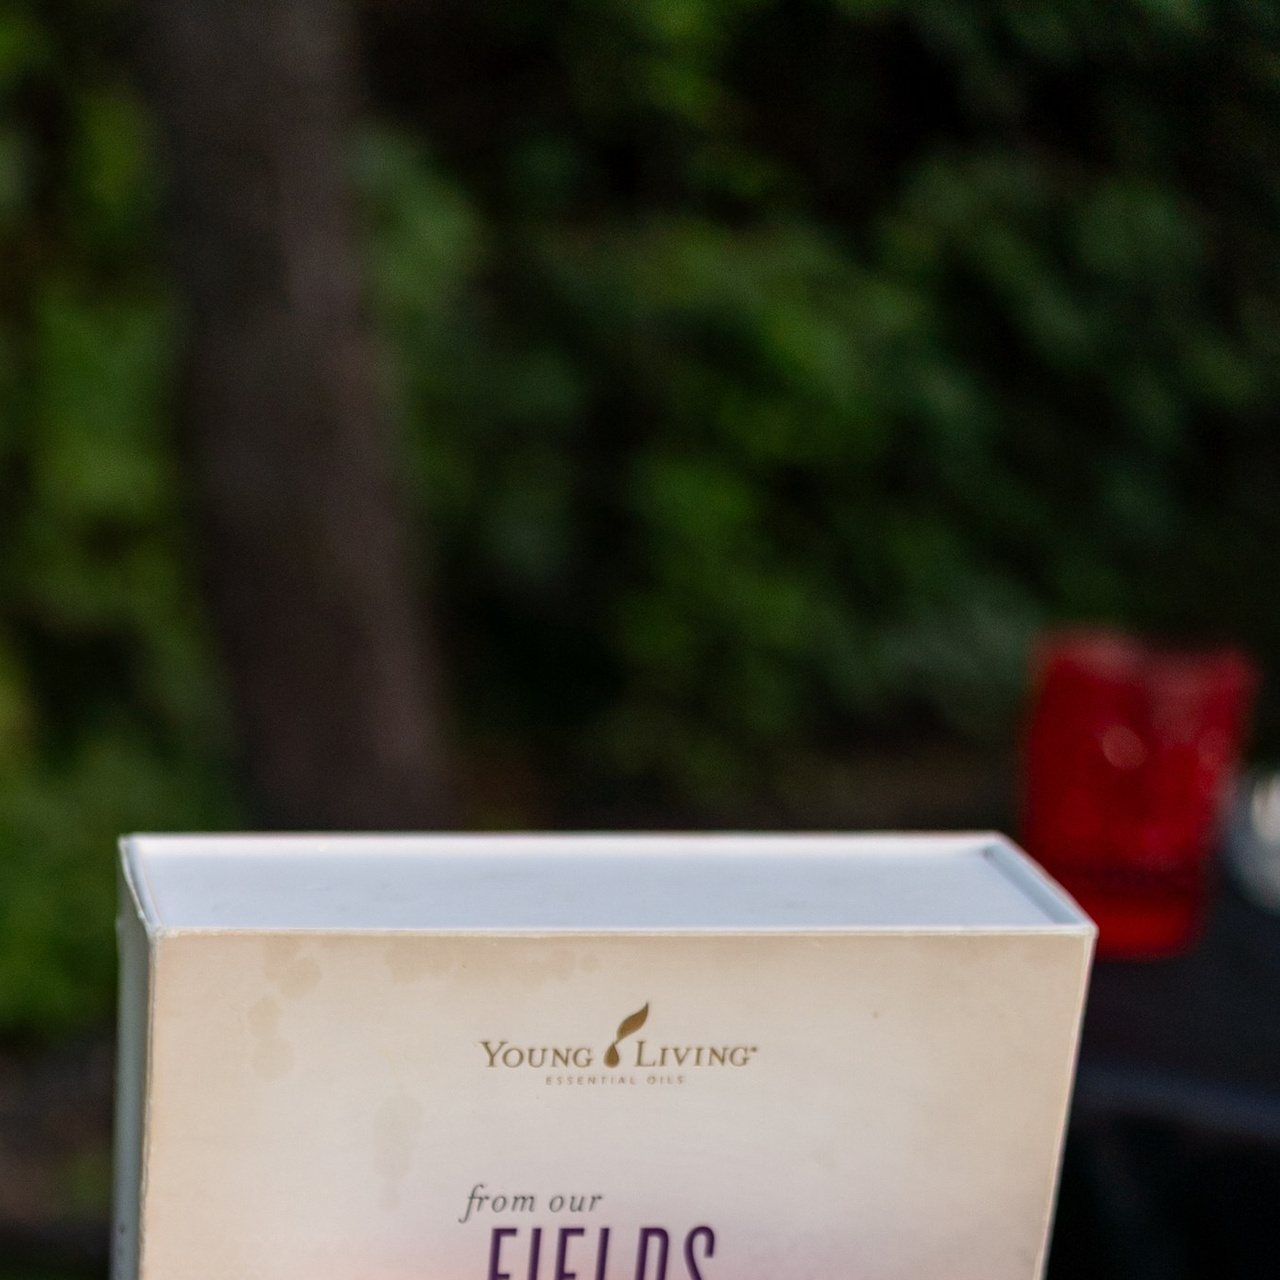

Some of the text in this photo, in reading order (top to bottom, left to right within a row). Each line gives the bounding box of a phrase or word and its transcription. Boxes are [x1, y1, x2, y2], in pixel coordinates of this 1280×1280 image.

[480, 1040, 593, 1068] YOUNG
[545, 1075, 686, 1086] ESSENTIAL OILS
[458, 1184, 602, 1223] from our
